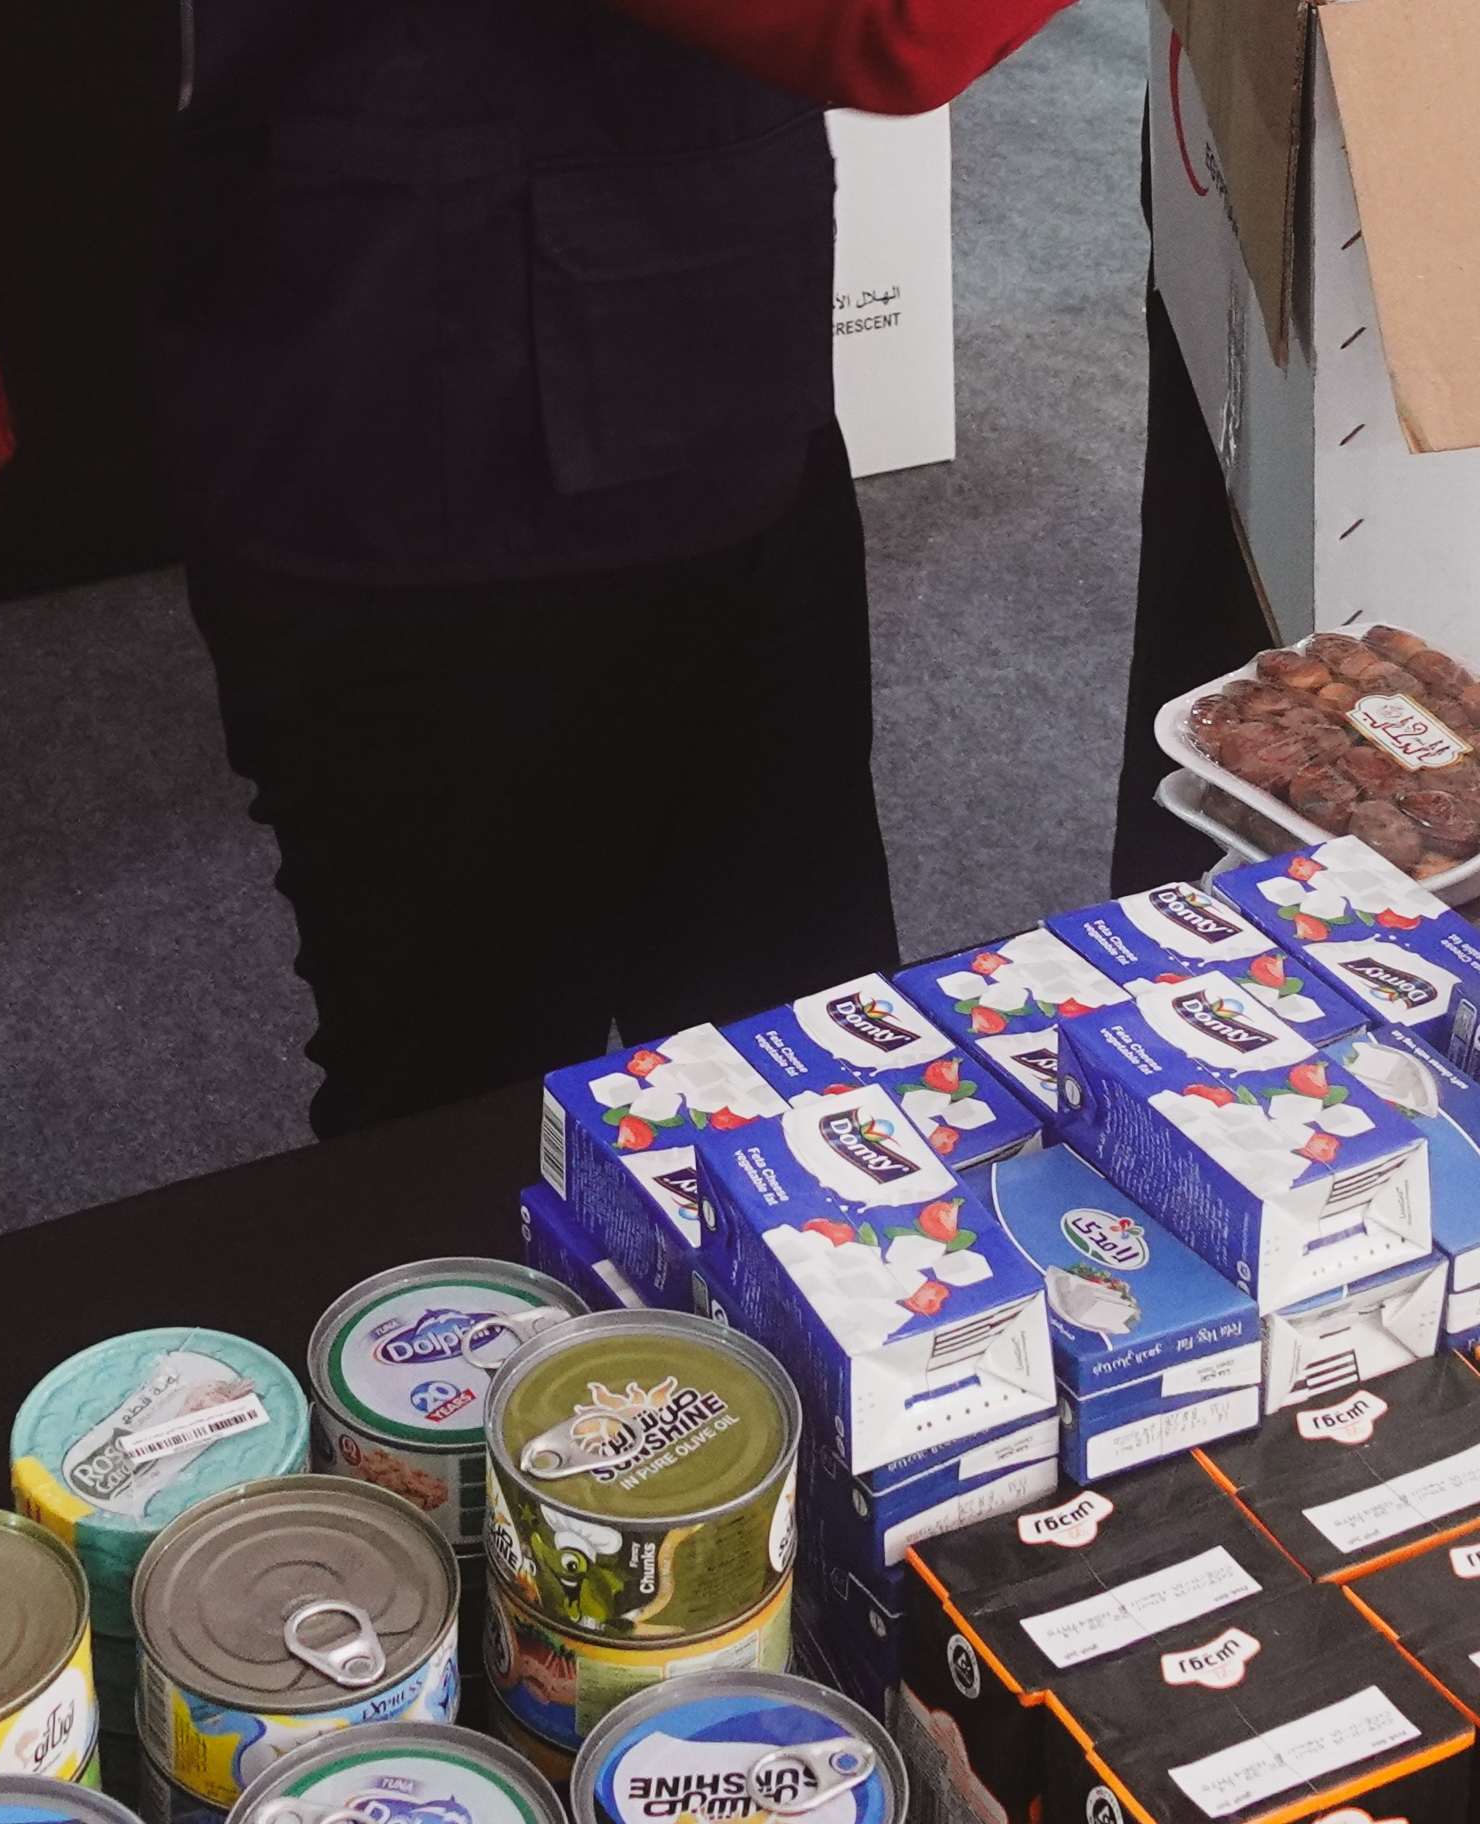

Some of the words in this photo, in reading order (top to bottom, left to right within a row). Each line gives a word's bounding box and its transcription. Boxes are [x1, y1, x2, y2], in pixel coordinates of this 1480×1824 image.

[856, 285, 901, 310] الهلال
[833, 312, 902, 337] RESCENT
[1157, 891, 1226, 934] Domty
[1354, 965, 1428, 1003] Domty
[835, 1000, 902, 1042] Domty
[1182, 998, 1262, 1043] Domty
[781, 1046, 809, 1073] Cheese
[1130, 1042, 1162, 1072] Cheese
[829, 1118, 902, 1171] Domty
[762, 1168, 790, 1203] Cheese
[620, 1477, 640, 1491] IN
[636, 1452, 679, 1480] PURE
[675, 1428, 716, 1456] OLIVE
[714, 1414, 741, 1431] OIL
[639, 1541, 657, 1594] Chunks
